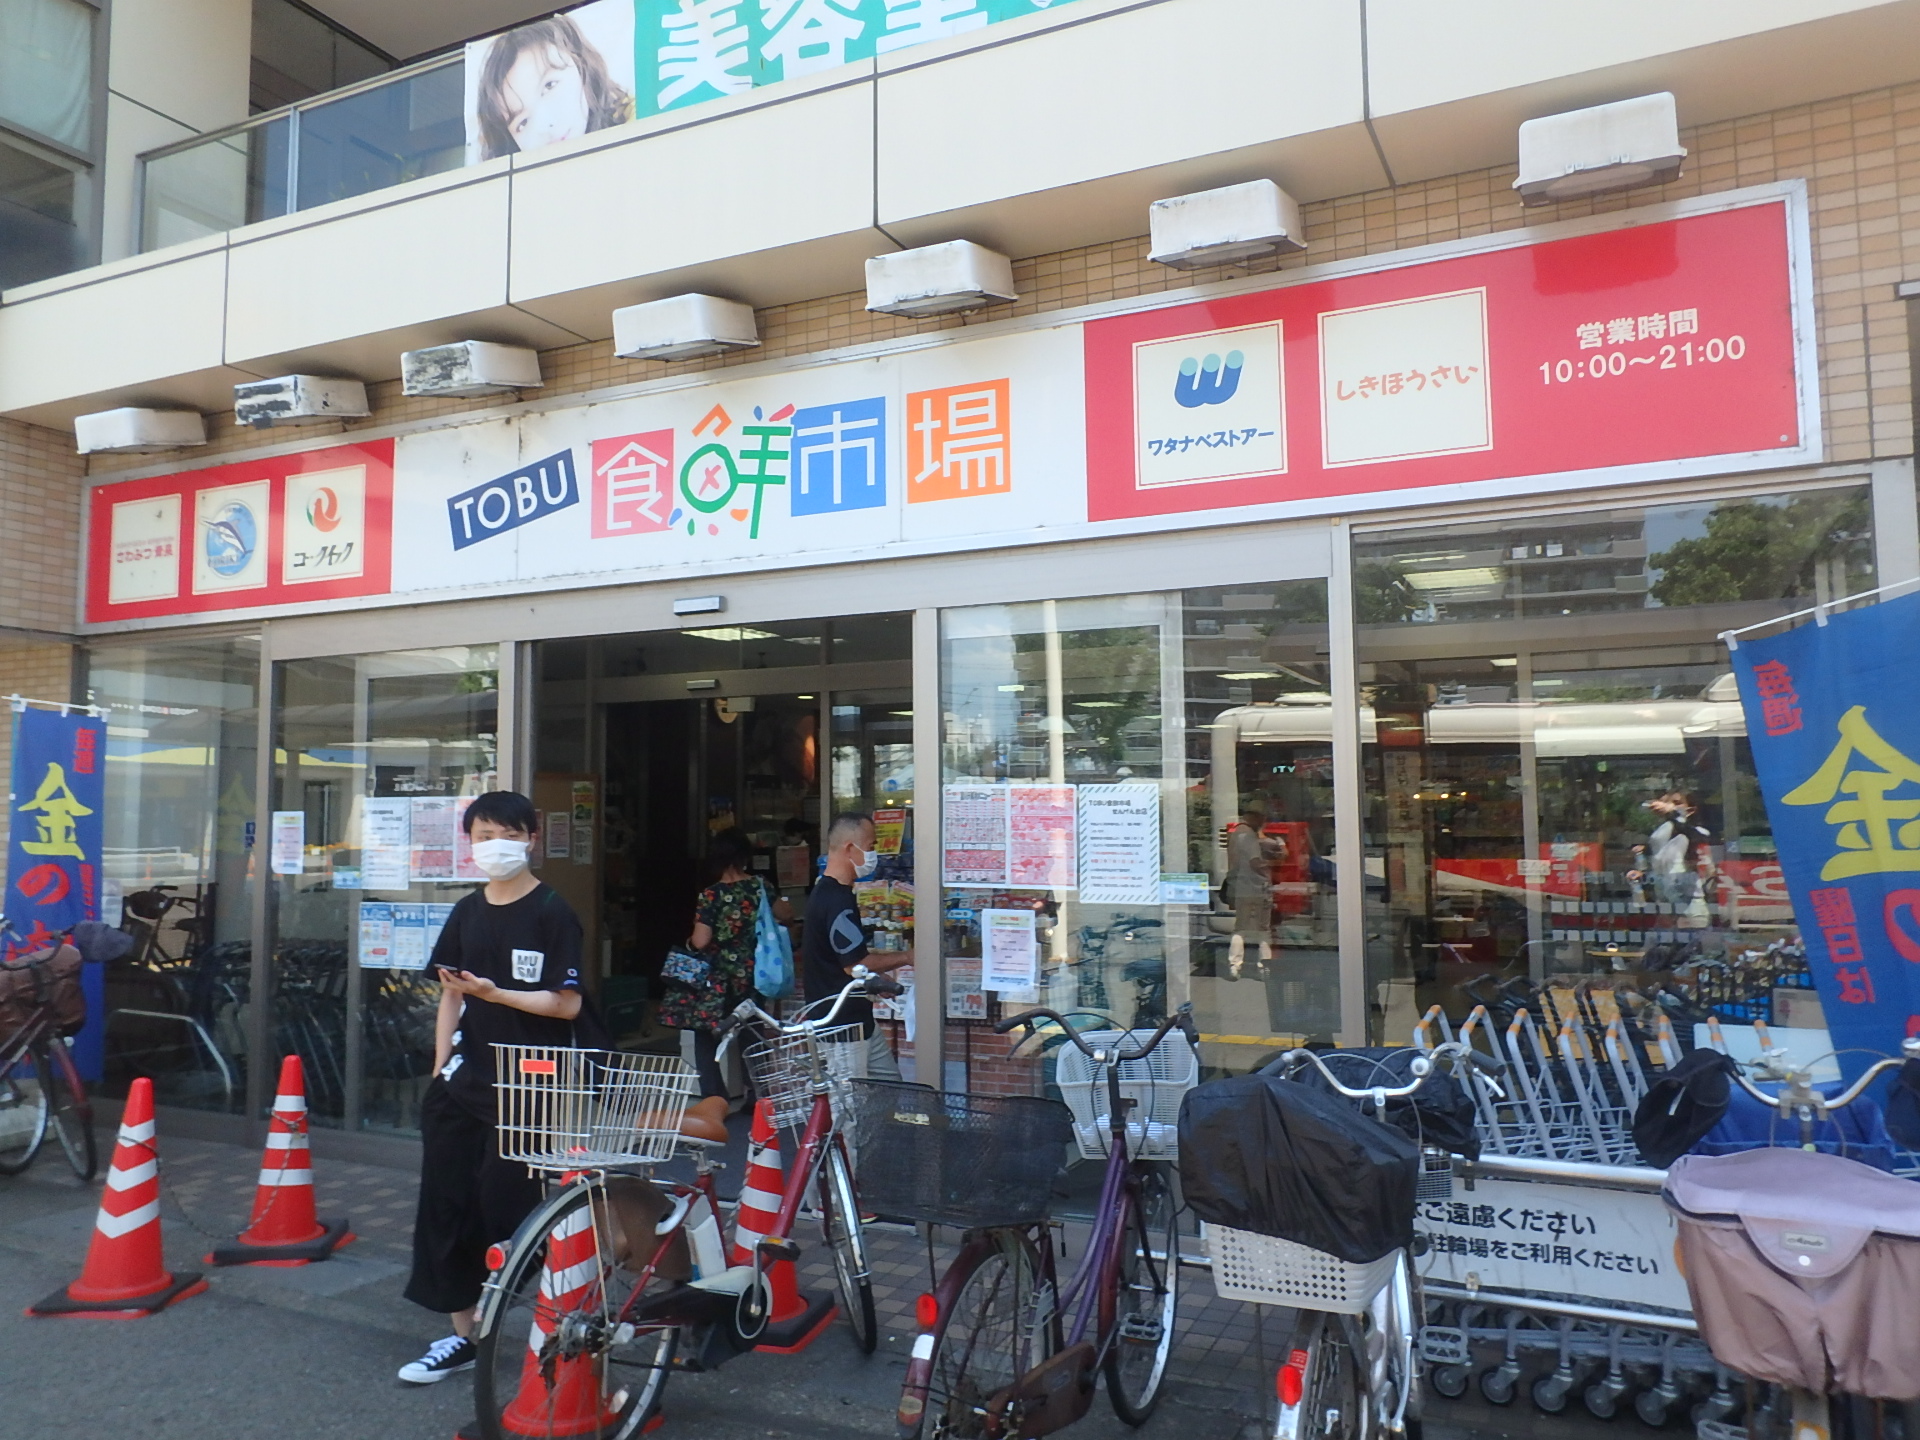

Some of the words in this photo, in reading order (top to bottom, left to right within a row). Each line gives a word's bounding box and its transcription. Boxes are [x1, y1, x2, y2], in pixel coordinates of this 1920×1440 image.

[1576, 308, 1698, 350] 営業時間
[1336, 365, 1479, 401] しきほうさい
[591, 377, 1012, 540] 食鮮市場
[1148, 428, 1274, 457] ワタナベストアー
[454, 459, 568, 541] TOBU
